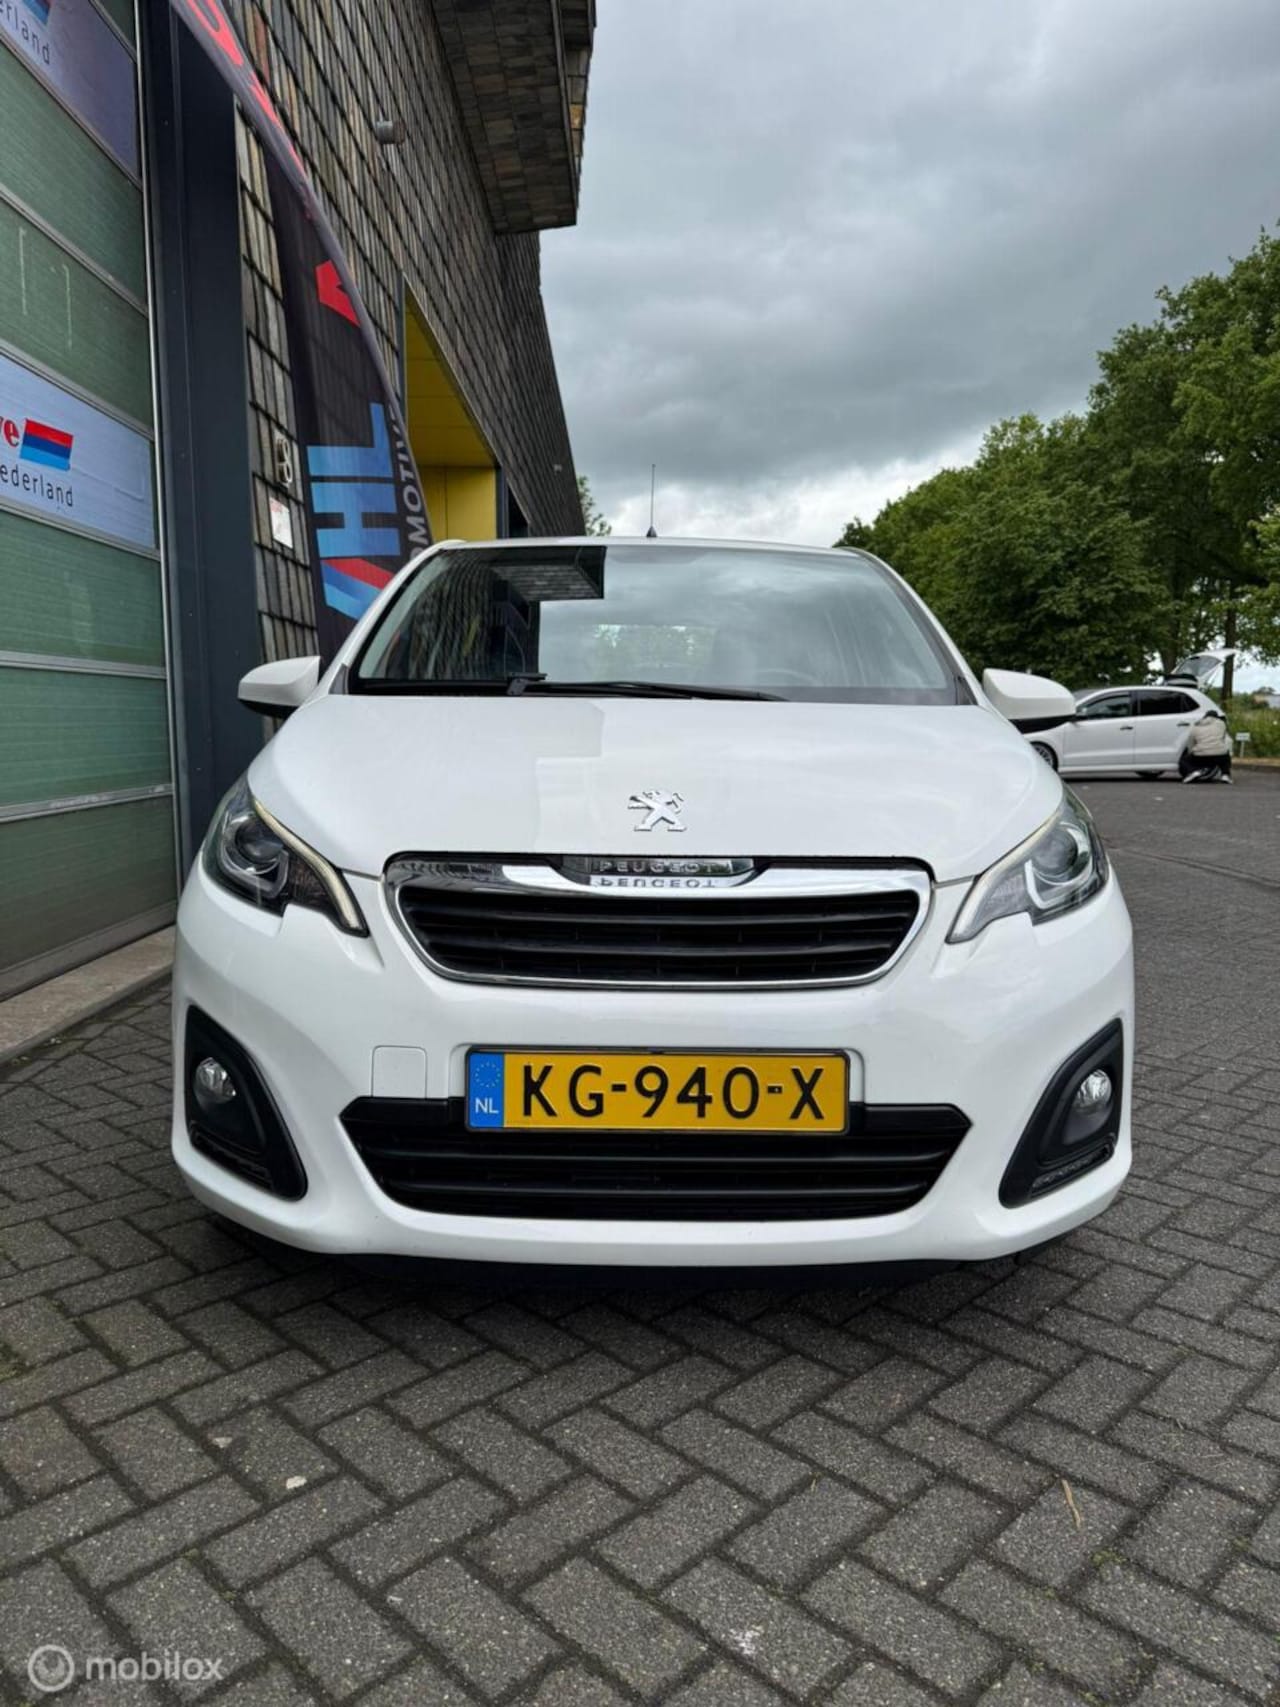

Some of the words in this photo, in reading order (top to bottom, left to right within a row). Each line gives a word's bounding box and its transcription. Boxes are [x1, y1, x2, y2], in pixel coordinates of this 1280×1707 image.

[0, 416, 20, 447] e
[387, 402, 430, 562] MOTIV
[600, 861, 714, 873] PEUGEOT
[475, 1098, 499, 1115] NL
[522, 1064, 825, 1120] KG-940-X
